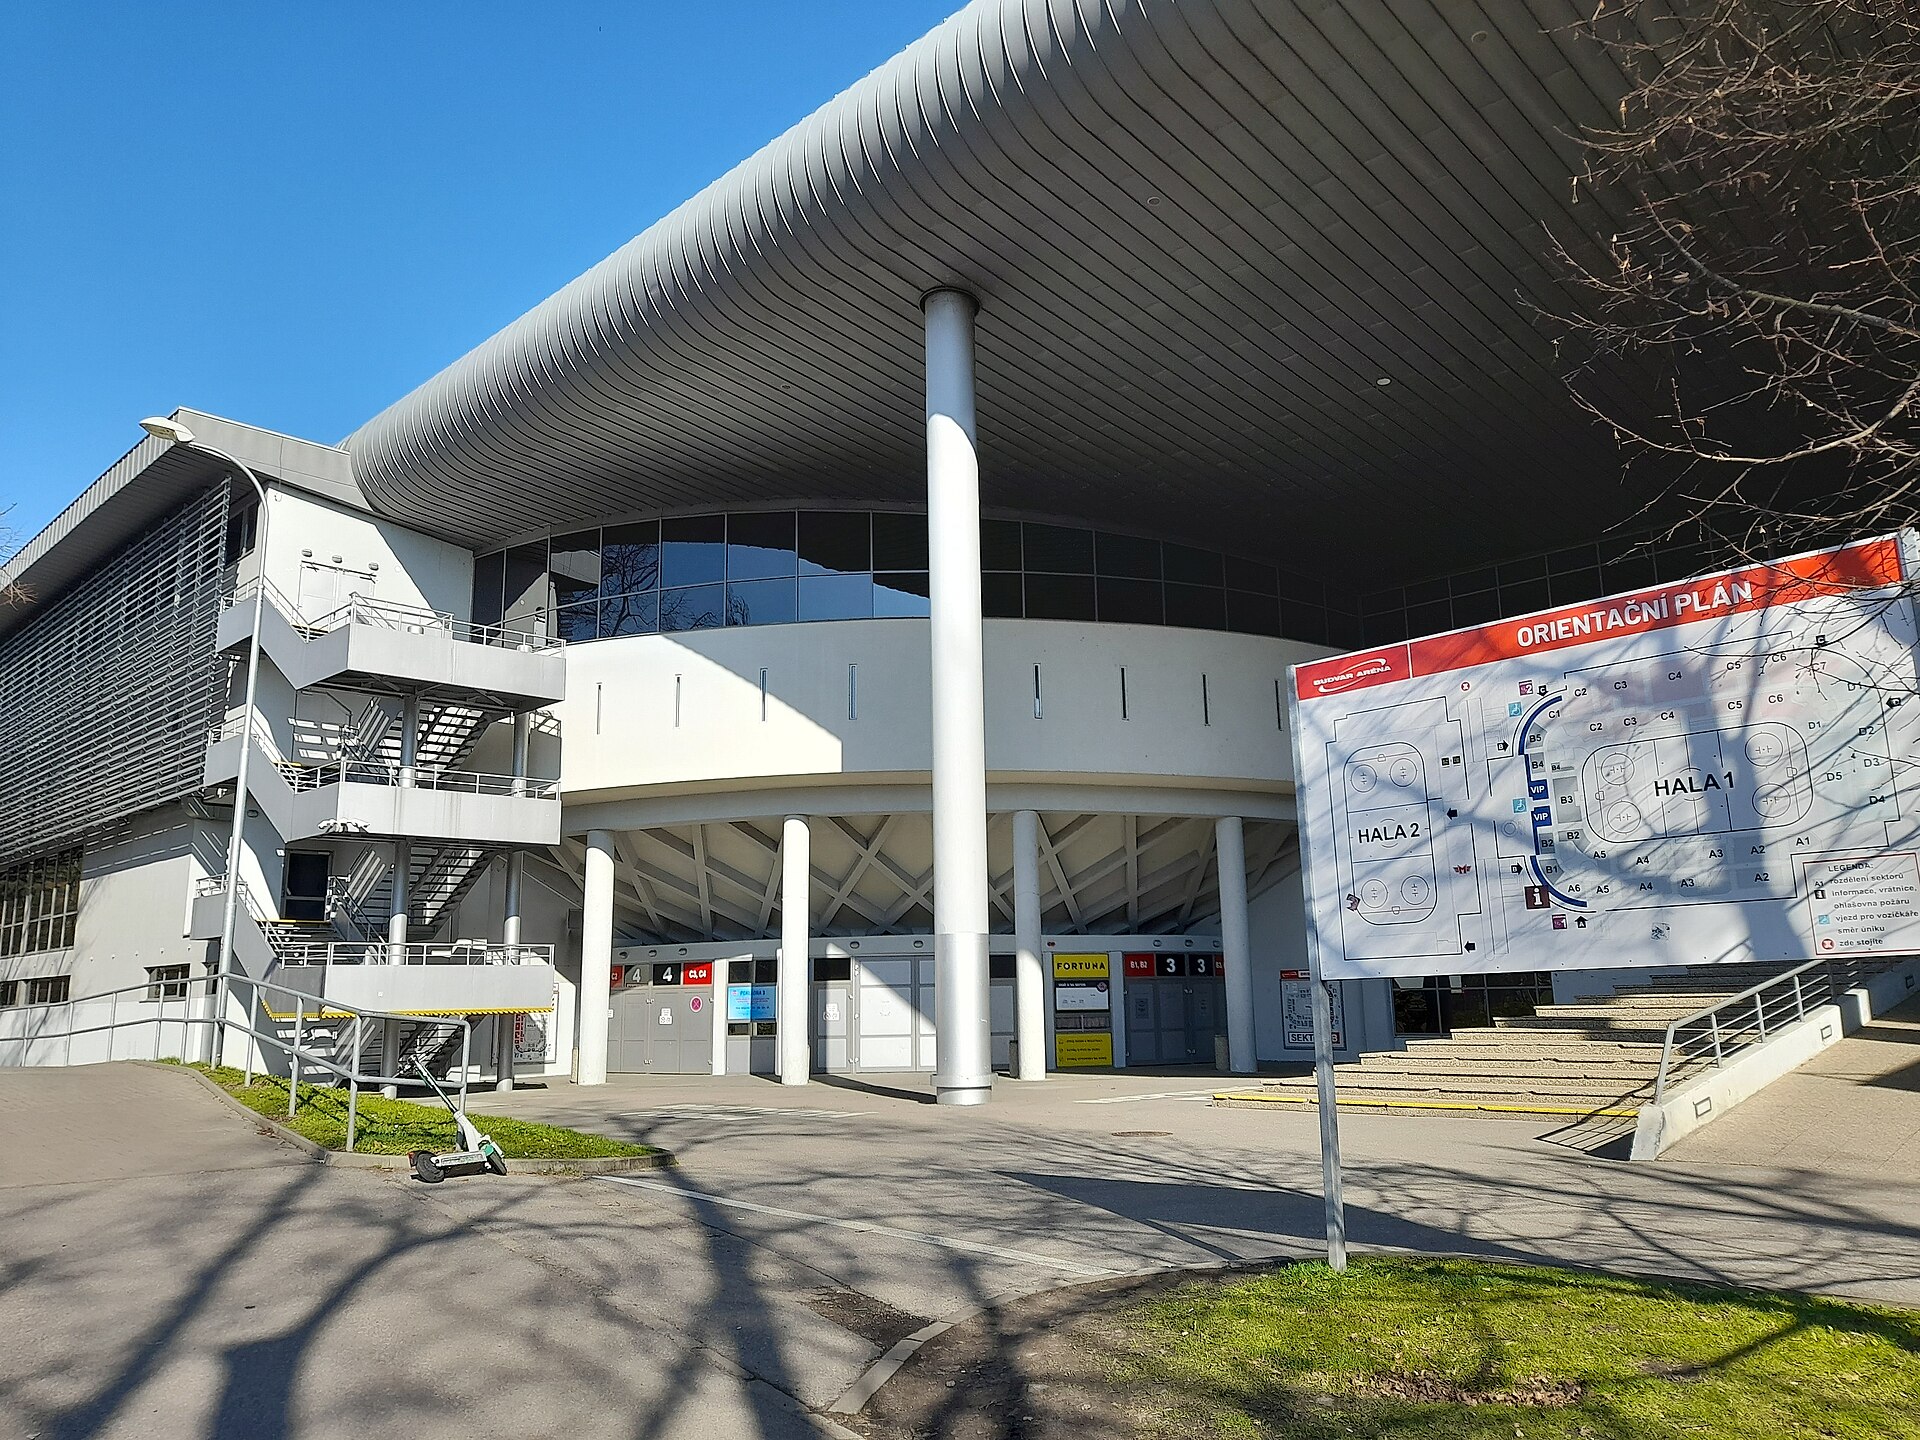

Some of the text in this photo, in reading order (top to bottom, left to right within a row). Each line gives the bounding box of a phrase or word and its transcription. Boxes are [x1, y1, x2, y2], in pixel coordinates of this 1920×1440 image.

[1517, 581, 1753, 647] ORIENTAČNÍ PLÁN
[1771, 653, 1787, 663] C6
[1726, 661, 1742, 671] C5
[1313, 673, 1354, 686] BUDVAR
[1668, 671, 1683, 681] C4
[1614, 681, 1628, 690] C3
[1574, 688, 1588, 697] C2
[1768, 693, 1784, 704] C6
[1727, 701, 1743, 710] C5
[1548, 710, 1561, 718] C1
[1660, 711, 1675, 720] C4
[1623, 717, 1637, 726] C3
[1808, 721, 1822, 730] D1
[1589, 723, 1603, 732] C2
[1529, 734, 1542, 743] B5
[1531, 760, 1544, 769] B4
[1863, 758, 1880, 767] D3
[1826, 772, 1843, 781] D5
[1654, 771, 1735, 797] HALA 1
[1530, 785, 1545, 794] VIP
[1560, 795, 1574, 804] B3
[1533, 812, 1548, 821] VIP
[1358, 822, 1420, 843] HALA 2
[1566, 832, 1580, 840] B2
[1541, 839, 1554, 847] B2
[1795, 837, 1810, 846] A1
[1593, 851, 1607, 859] A5
[1708, 849, 1724, 858] A3
[1750, 846, 1766, 855] A2
[1635, 856, 1650, 865] A4
[1545, 865, 1558, 874] B1
[1754, 873, 1770, 882] A2
[1639, 882, 1654, 891] A4
[1680, 879, 1695, 887] A3
[1567, 884, 1581, 892] A6
[1596, 885, 1610, 893] A5
[1835, 913, 1858, 922] vjezd
[1860, 914, 1875, 922] pro
[1839, 939, 1854, 947] zde
[1056, 962, 1106, 971] FORTUNA
[1166, 958, 1176, 973] 3
[1197, 958, 1206, 973] 3
[632, 968, 641, 983] 4
[663, 966, 673, 982] 4
[1291, 1033, 1314, 1042] SEKT
